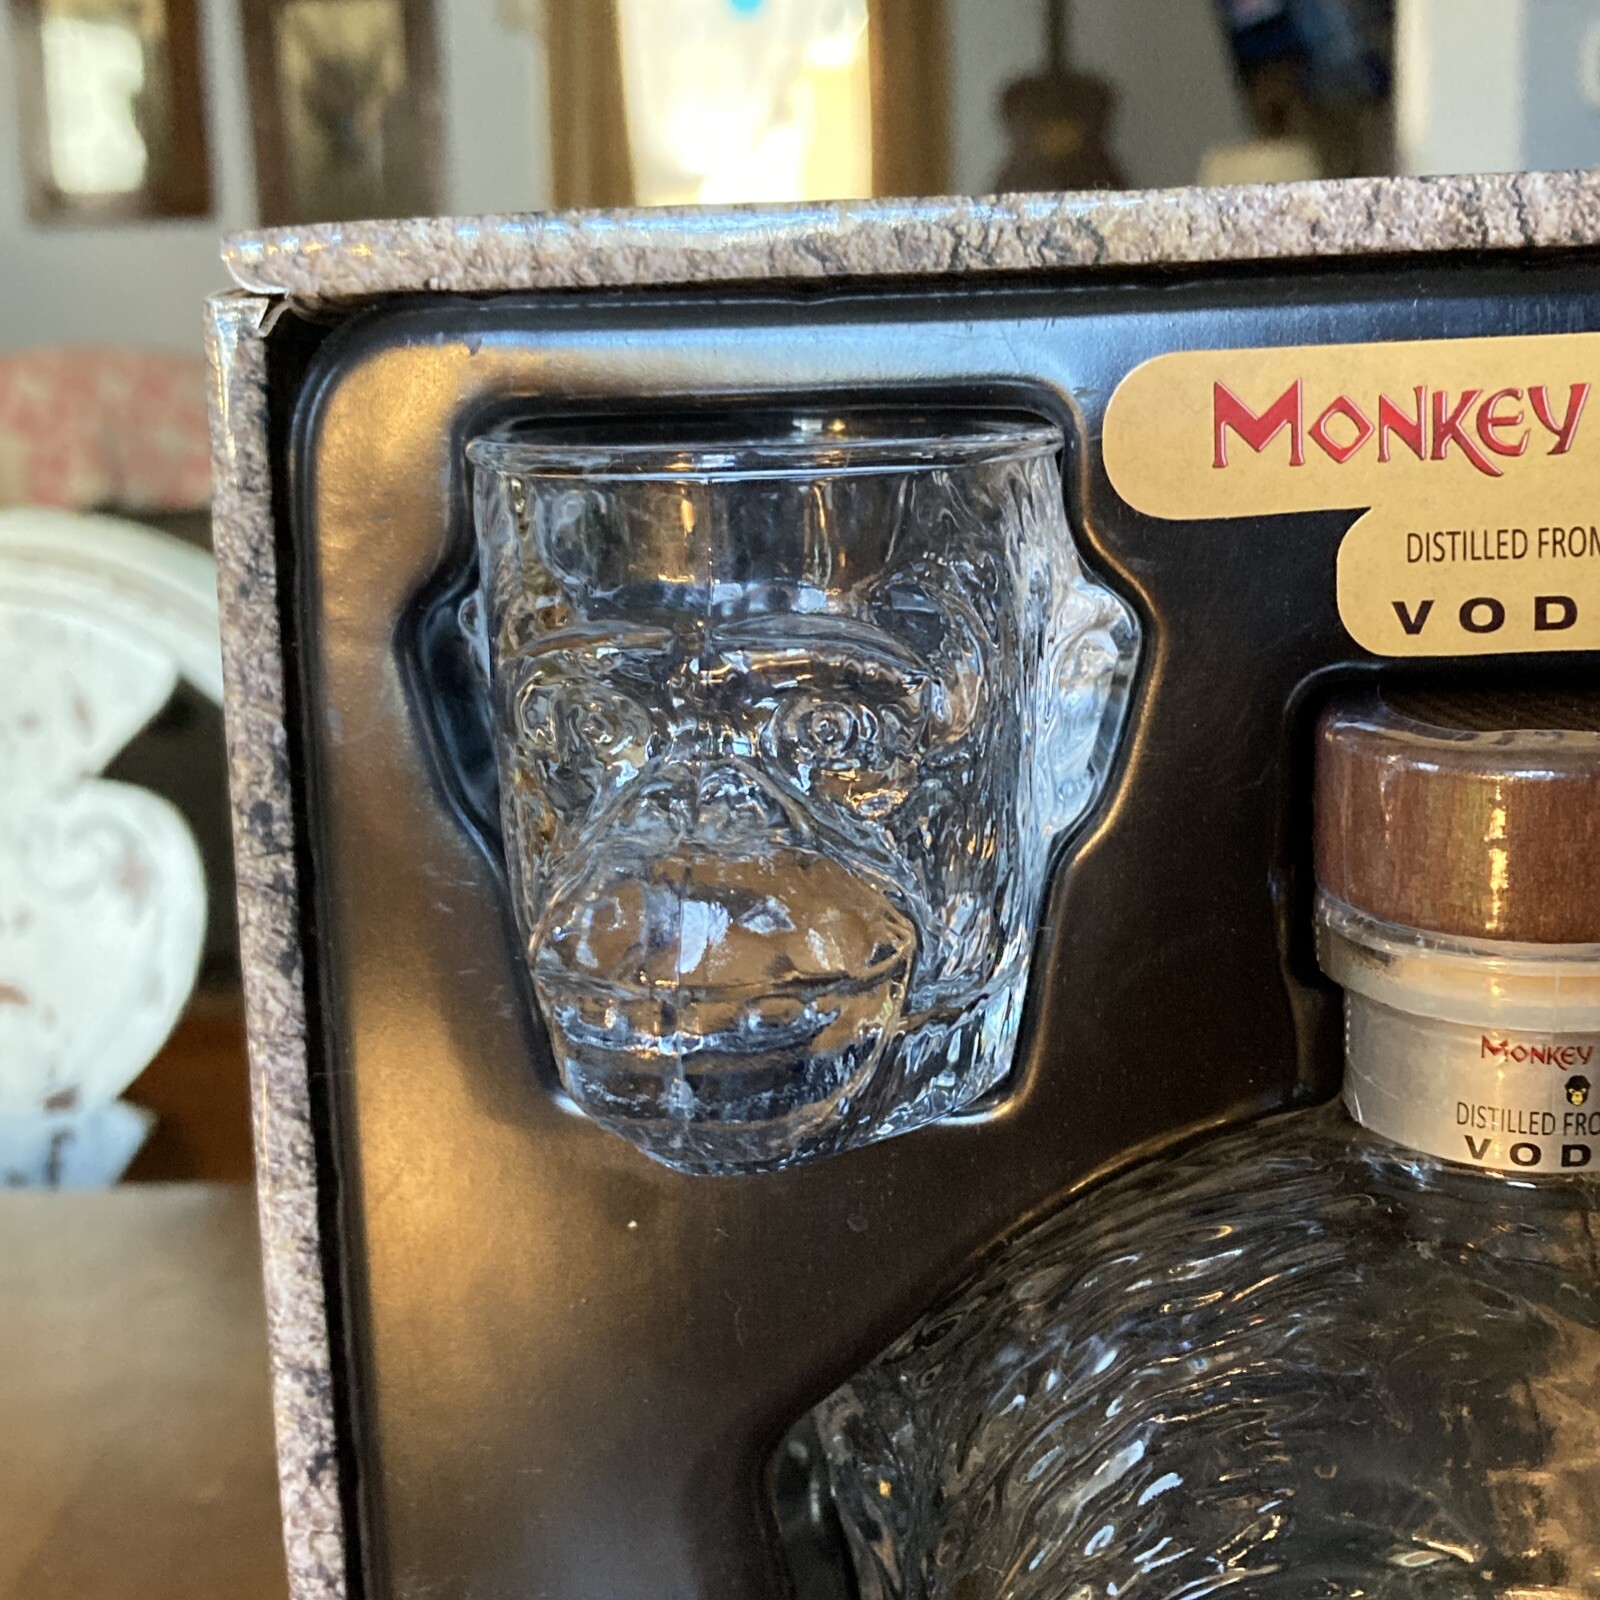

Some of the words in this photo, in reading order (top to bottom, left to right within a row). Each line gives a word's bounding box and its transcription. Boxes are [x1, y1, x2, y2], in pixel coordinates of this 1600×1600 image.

[1213, 378, 1590, 477] MONKEY
[1407, 529, 1528, 563] DISTILLED
[1481, 1035, 1594, 1070] MONKEY
[1457, 1102, 1555, 1135] DISTILLED
